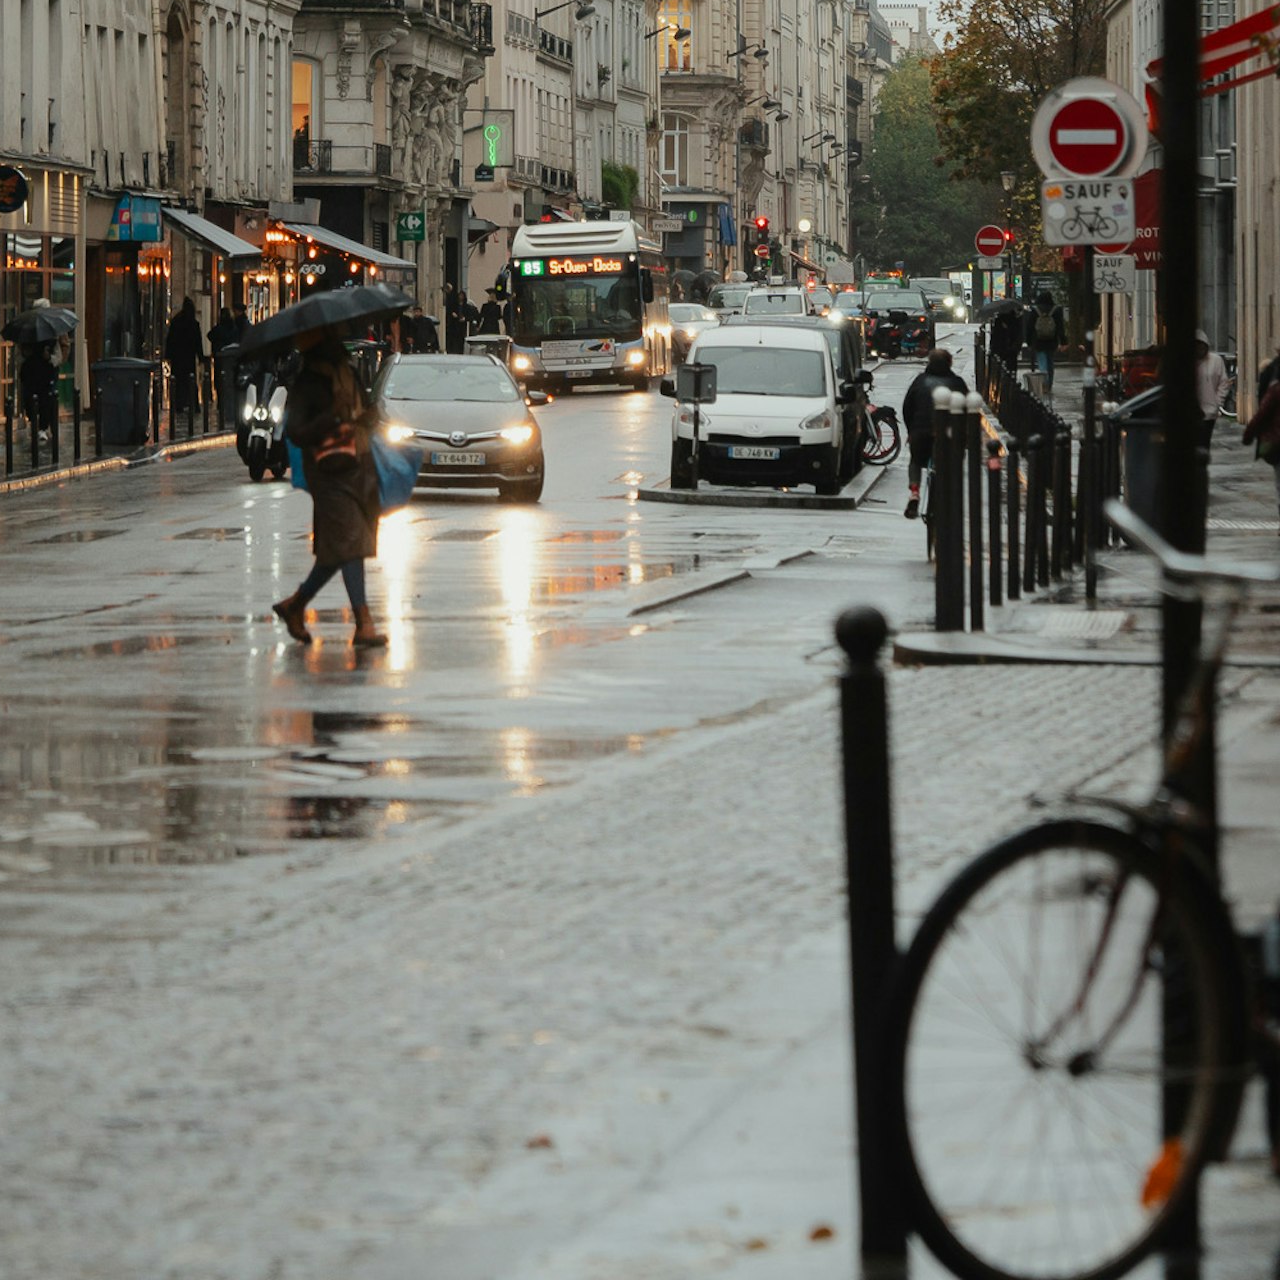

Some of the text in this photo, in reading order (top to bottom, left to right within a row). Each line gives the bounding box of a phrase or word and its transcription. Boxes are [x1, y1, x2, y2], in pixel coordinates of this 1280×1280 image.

[1064, 183, 1113, 200] SAUF
[523, 261, 541, 276] 85
[593, 257, 622, 273] Docks
[1095, 258, 1124, 268] SAUF
